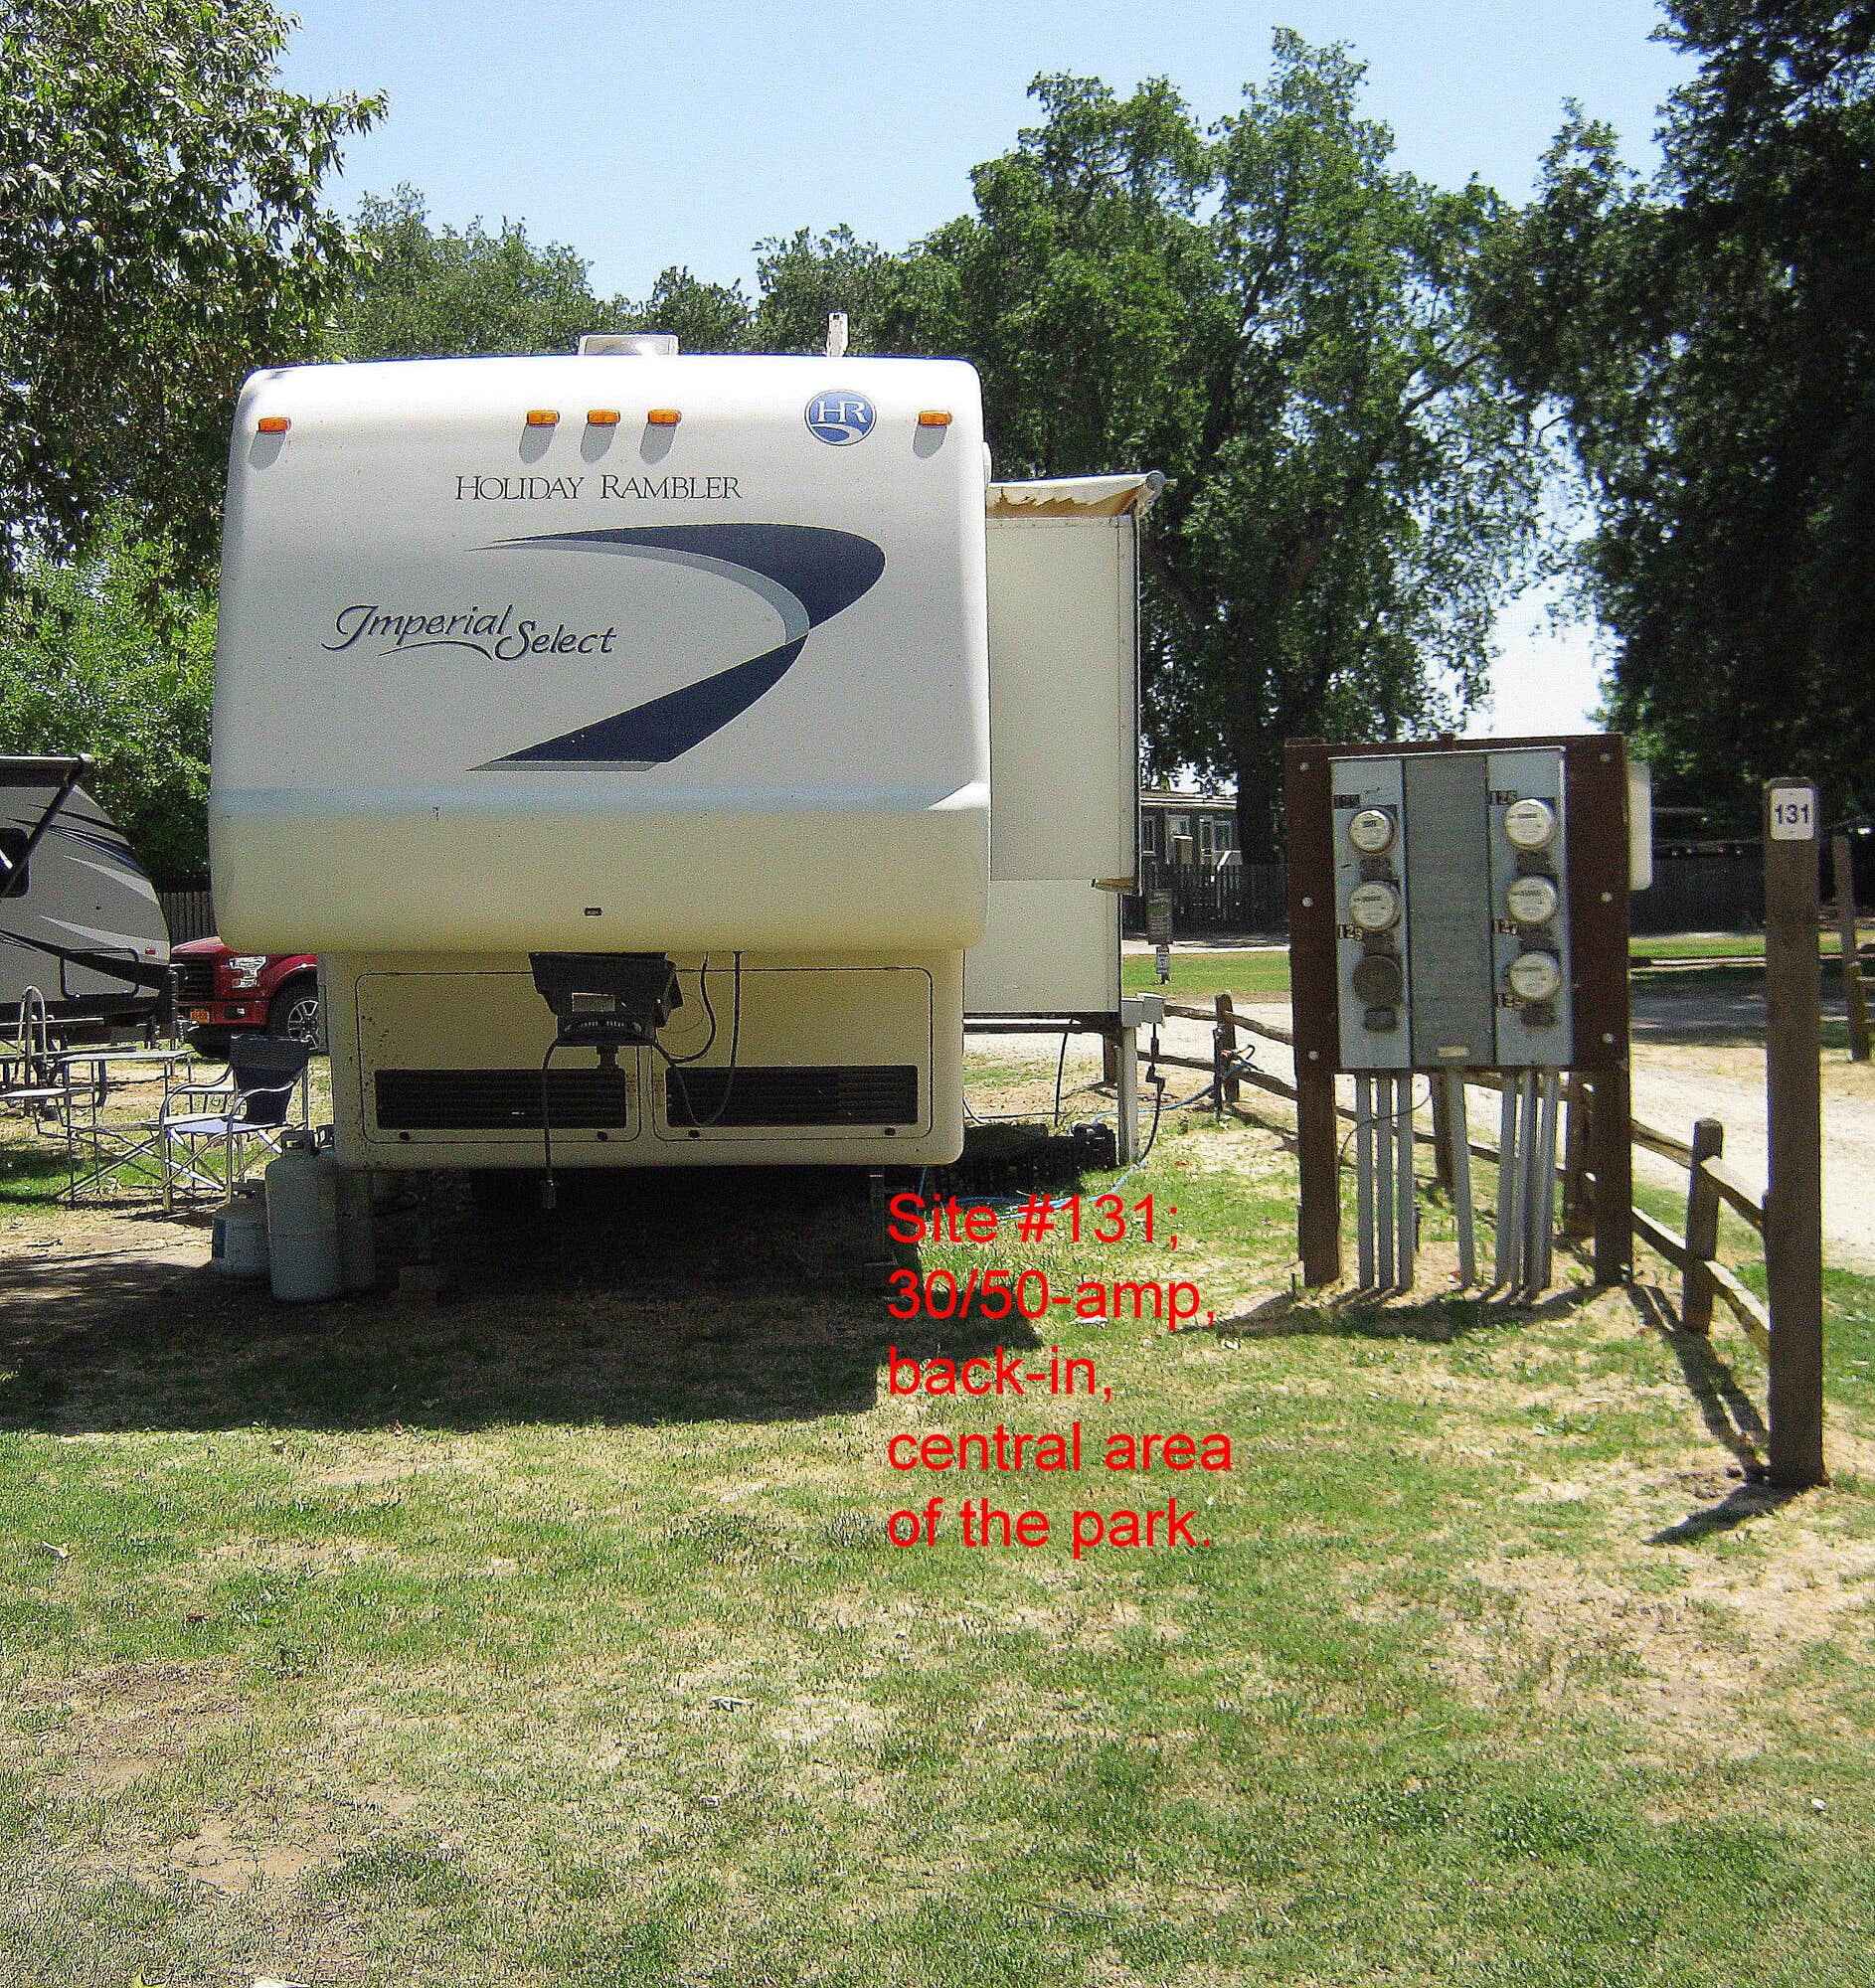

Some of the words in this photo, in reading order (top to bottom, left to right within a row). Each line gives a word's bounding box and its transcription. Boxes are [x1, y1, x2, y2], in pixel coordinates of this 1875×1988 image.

[817, 400, 868, 422] HR
[455, 475, 585, 500] HOLIDAY
[600, 474, 743, 499] RAMBLER
[321, 604, 514, 651] Imperial
[495, 619, 617, 662] Select
[1775, 803, 1809, 825] 131
